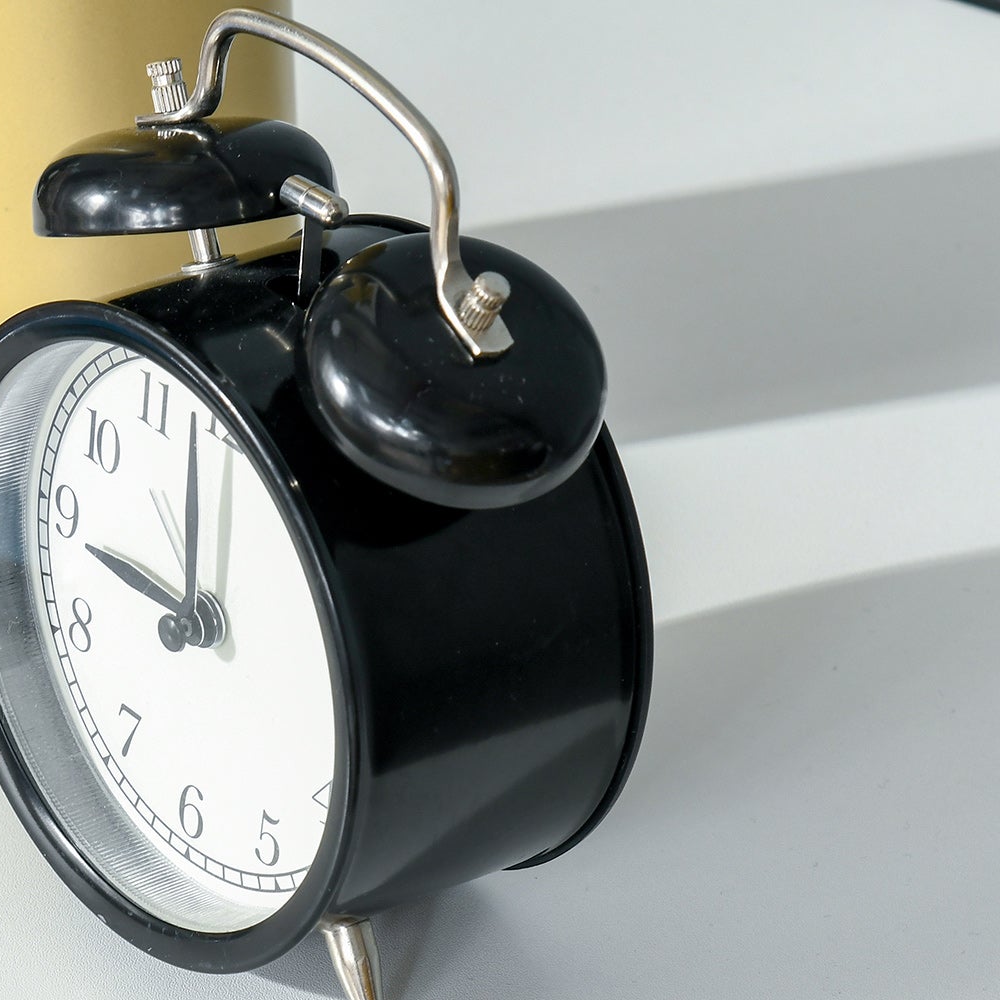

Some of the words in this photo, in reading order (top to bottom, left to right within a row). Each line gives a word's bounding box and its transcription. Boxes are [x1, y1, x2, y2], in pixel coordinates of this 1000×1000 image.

[137, 368, 171, 440] 11
[83, 406, 121, 474] 10
[55, 484, 79, 539] 9
[68, 597, 93, 653] 8
[118, 703, 141, 758] 7
[179, 784, 203, 839] 6
[254, 809, 280, 866] 5
